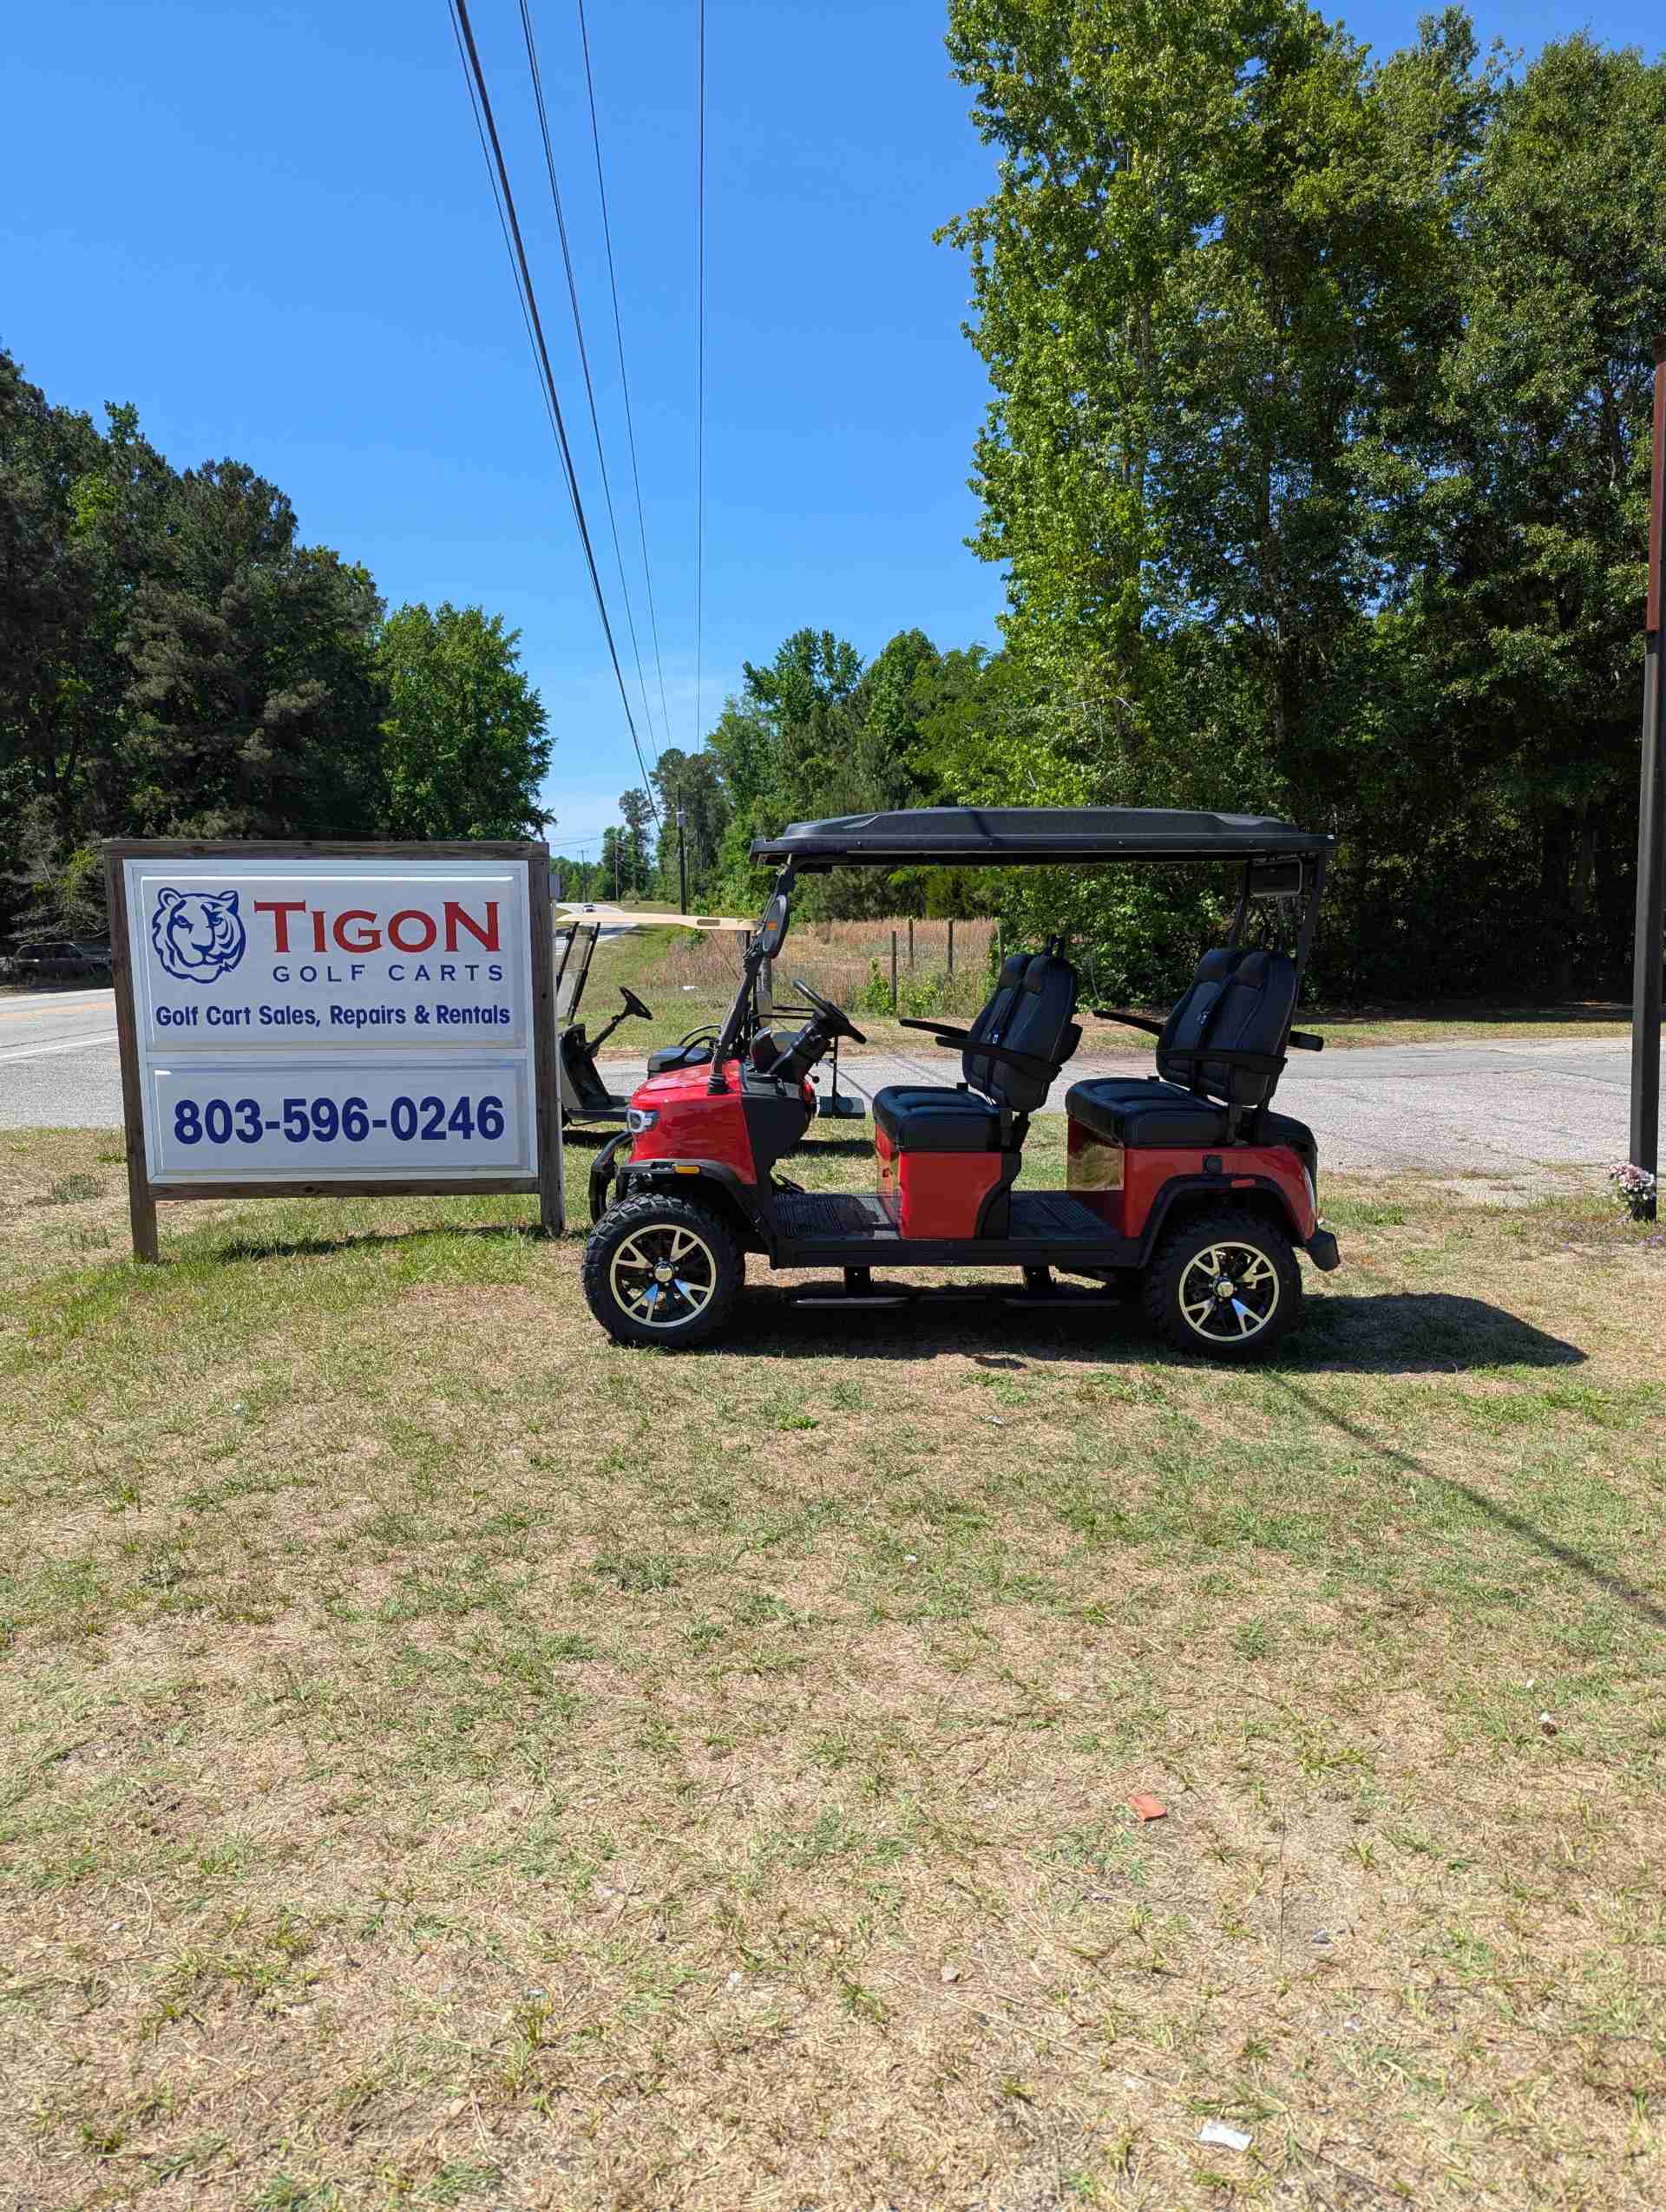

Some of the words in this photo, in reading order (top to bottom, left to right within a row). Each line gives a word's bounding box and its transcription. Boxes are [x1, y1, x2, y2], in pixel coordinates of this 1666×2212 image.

[253, 900, 502, 954] TIGON
[272, 964, 368, 983] GOLF
[388, 964, 504, 982] CARTS
[155, 1005, 200, 1026] Golf
[206, 1005, 252, 1025] Cart
[259, 1005, 322, 1028] Sales,
[329, 1004, 407, 1030] Repairs
[413, 1005, 432, 1024] &
[435, 1003, 511, 1025] Rentals
[174, 1095, 505, 1145] 803-596-0246
